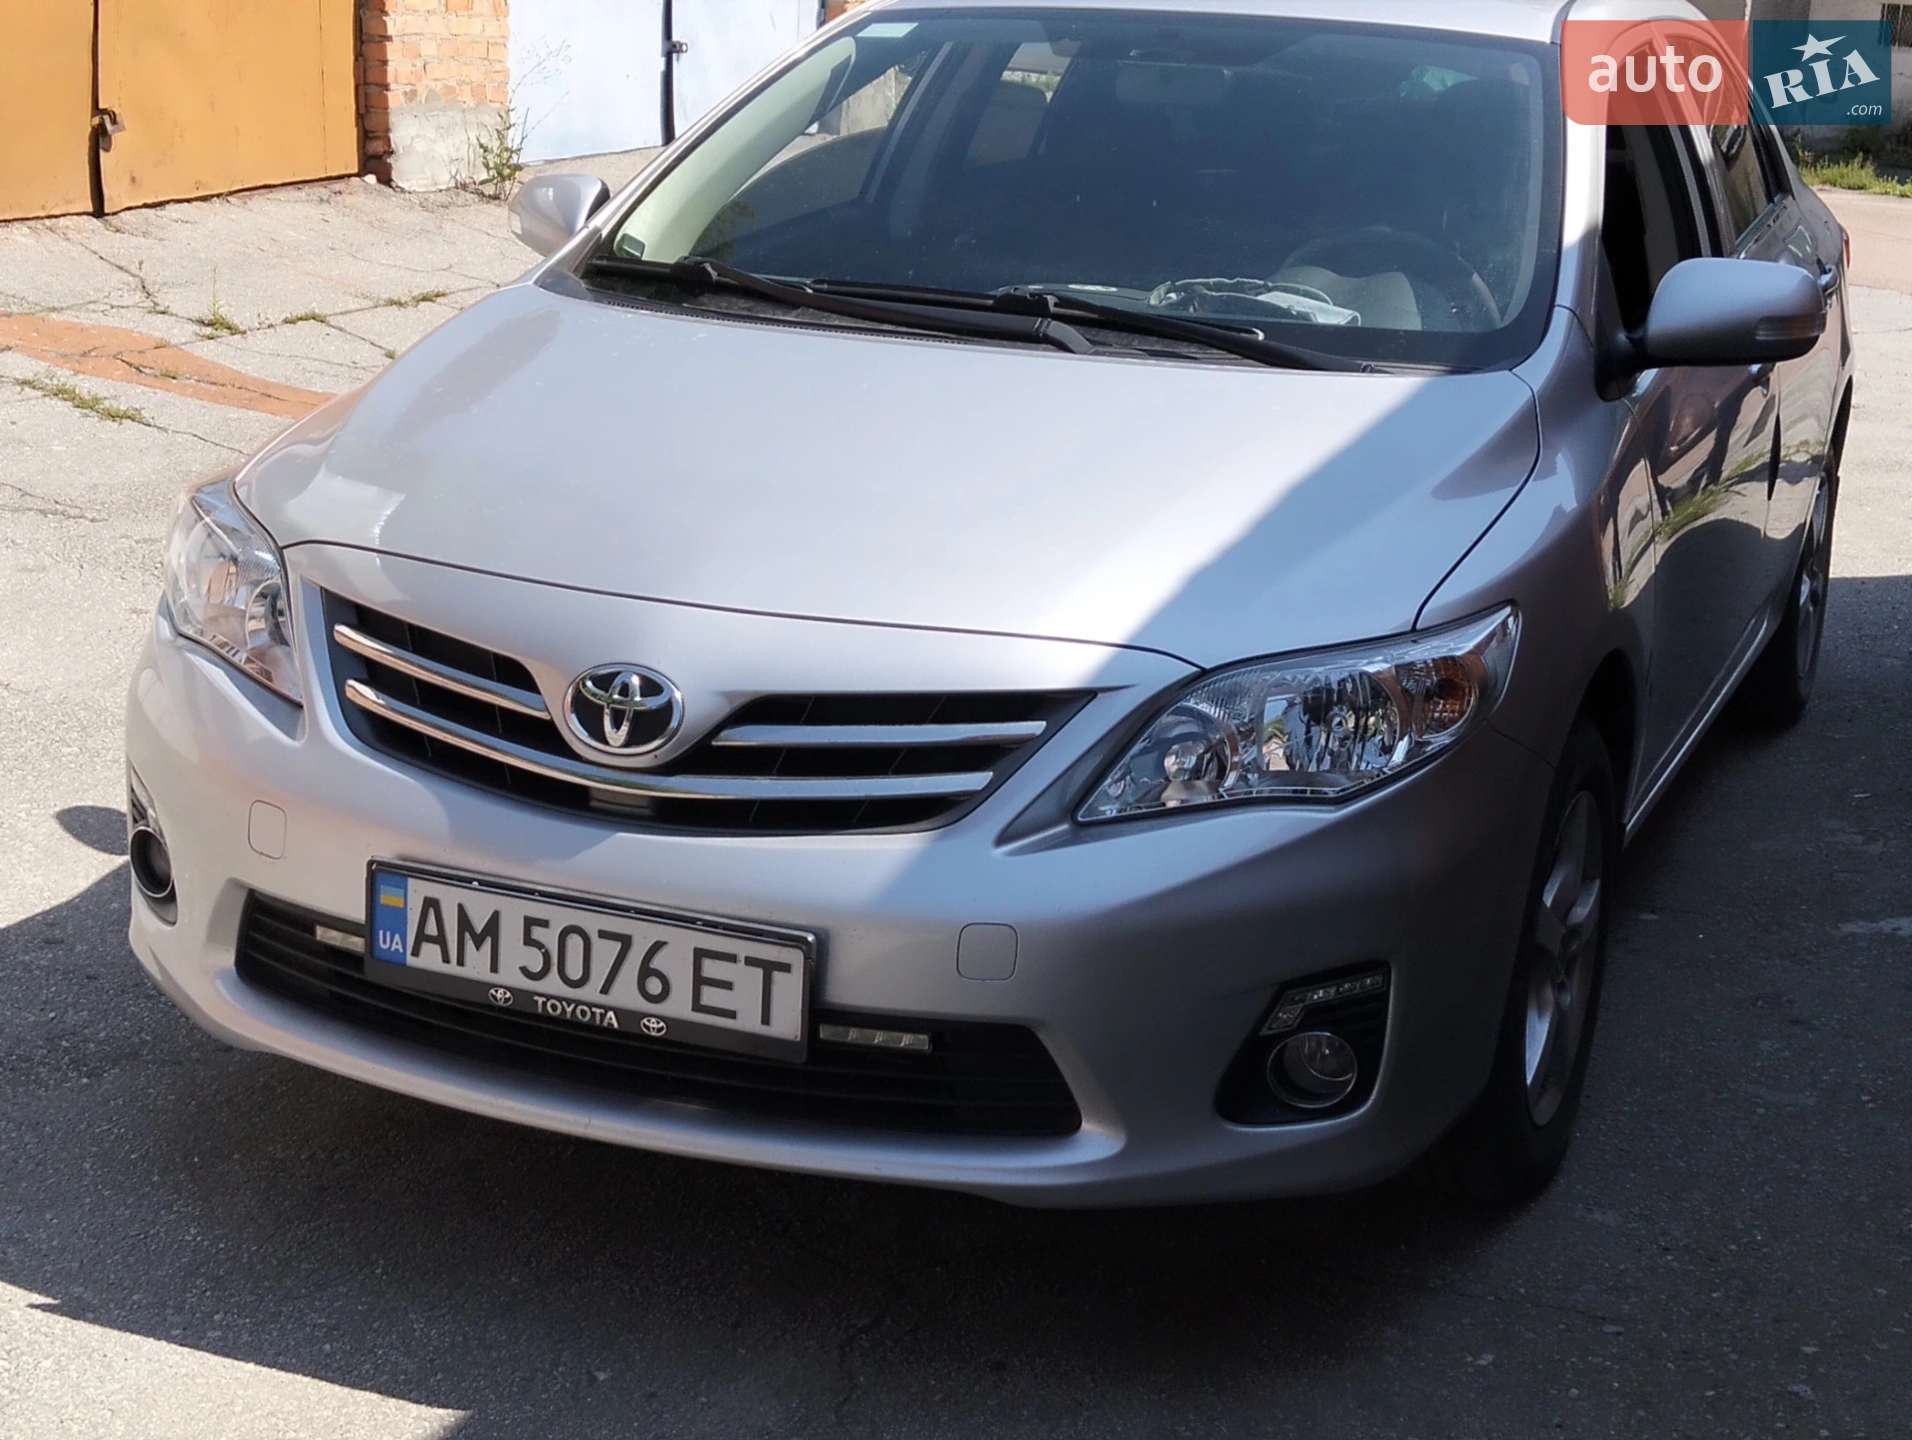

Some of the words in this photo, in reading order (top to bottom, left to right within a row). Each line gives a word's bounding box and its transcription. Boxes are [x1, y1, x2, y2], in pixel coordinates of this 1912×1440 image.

[378, 929, 404, 954] UA
[410, 896, 500, 974] AM
[518, 915, 672, 1003] 5076
[691, 947, 792, 1026] ET
[533, 995, 619, 1030] TOYOTA
